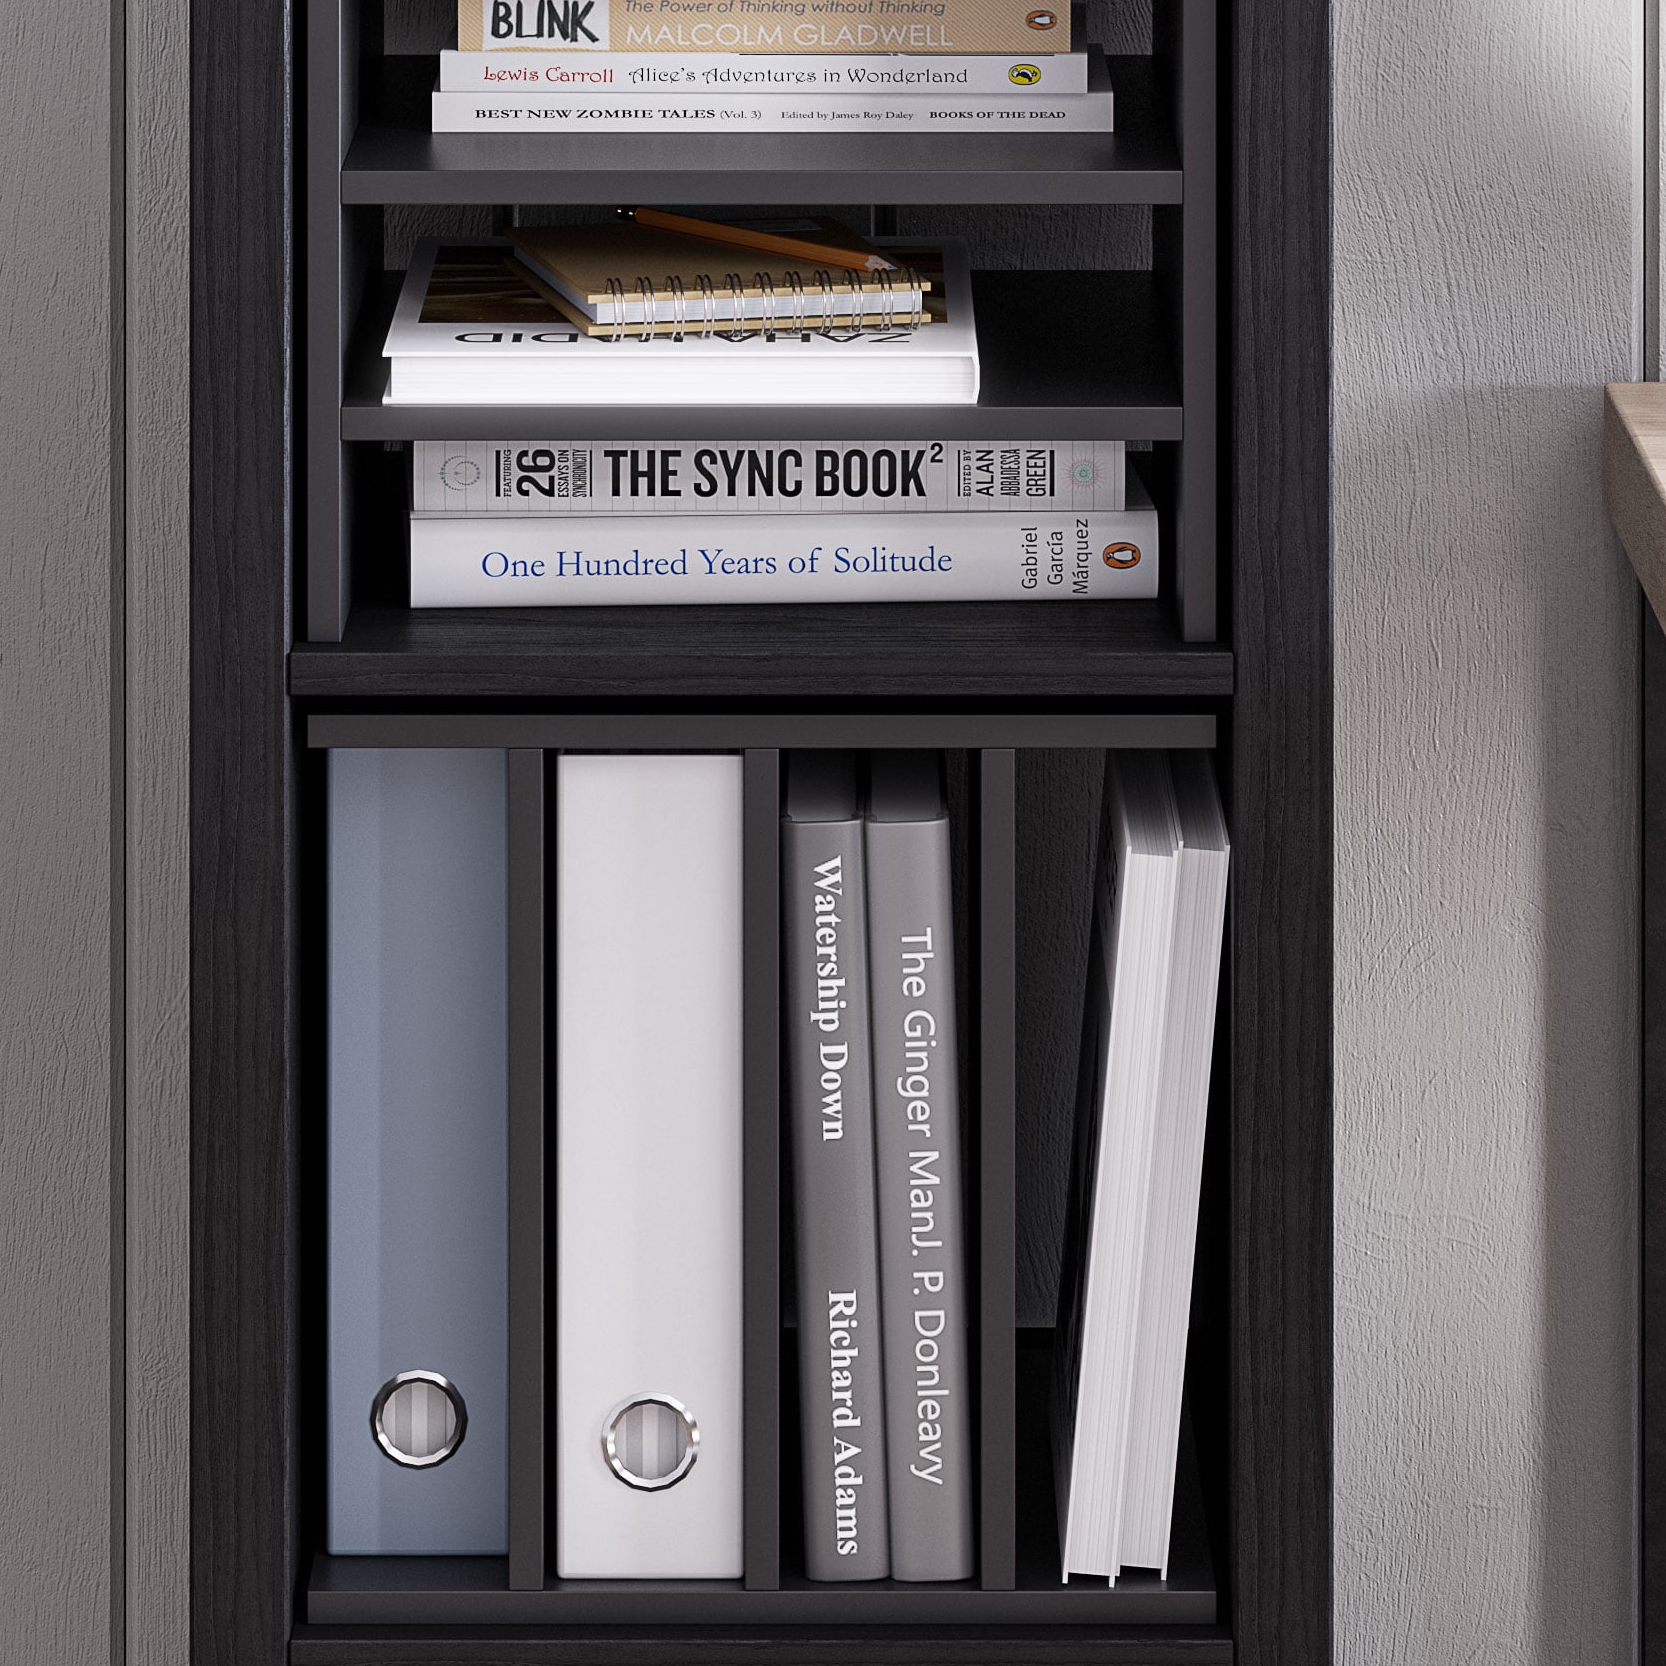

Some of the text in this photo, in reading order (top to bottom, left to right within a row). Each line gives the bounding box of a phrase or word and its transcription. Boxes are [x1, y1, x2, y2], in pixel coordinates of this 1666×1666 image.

[624, 0, 946, 17] The Power of Thinking without Thinking
[626, 23, 953, 47] MALCOLM GLADWELL
[483, 65, 615, 84] Lewis Carroll
[627, 66, 969, 84] Alice's Adventures in Wonderland
[475, 109, 762, 120] BEST NEW ZOMBIE TALES (Vol. 3)
[781, 110, 915, 122] Edited by James Roy Daley
[929, 111, 1066, 119] BOOKS OF THE DEAD
[503, 449, 512, 497] FEATURING
[516, 449, 555, 498] 26
[558, 449, 569, 498] ESSAYS ON
[572, 449, 587, 498] SYNCHRONICITY
[603, 449, 682, 497] THE
[693, 449, 803, 497] SYNC
[963, 450, 972, 497] EDITED BY
[976, 449, 994, 497] ALAN
[1000, 448, 1020, 497] ABBADESSA
[1026, 449, 1046, 497] GREEN
[481, 545, 953, 578] One Hundred Years of Solitude
[1021, 527, 1037, 589] Gabriel
[1047, 531, 1063, 585] García
[1071, 519, 1092, 594] Márquez
[900, 925, 933, 997] The
[809, 855, 848, 1141] Watership Down
[893, 1010, 937, 1138] Ginger
[826, 1288, 863, 1557] Richard Adams
[908, 1311, 950, 1486] Donleavy
